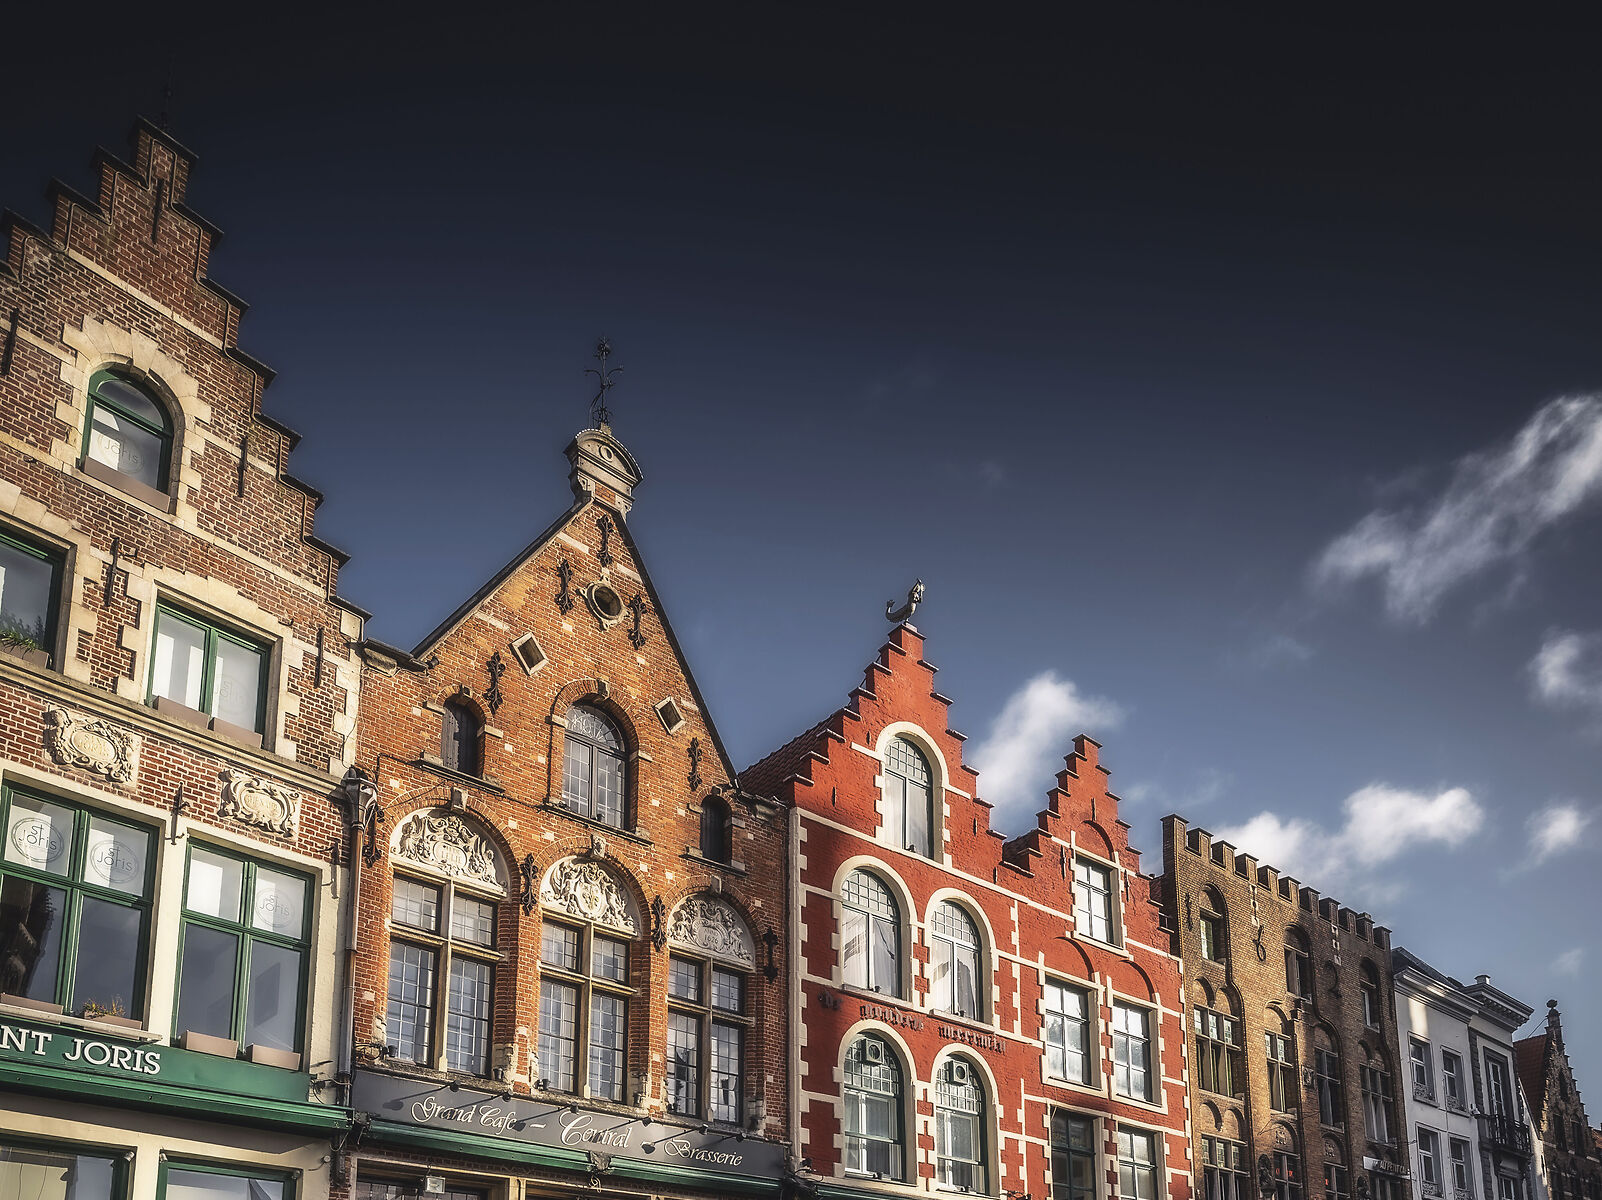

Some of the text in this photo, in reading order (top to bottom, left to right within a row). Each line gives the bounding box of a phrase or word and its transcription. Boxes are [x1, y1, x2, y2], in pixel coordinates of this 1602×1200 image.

[65, 1038, 161, 1075] JORIS
[411, 1096, 475, 1123] Grand
[559, 1110, 632, 1148] Central
[664, 1137, 743, 1167] Brasserie
